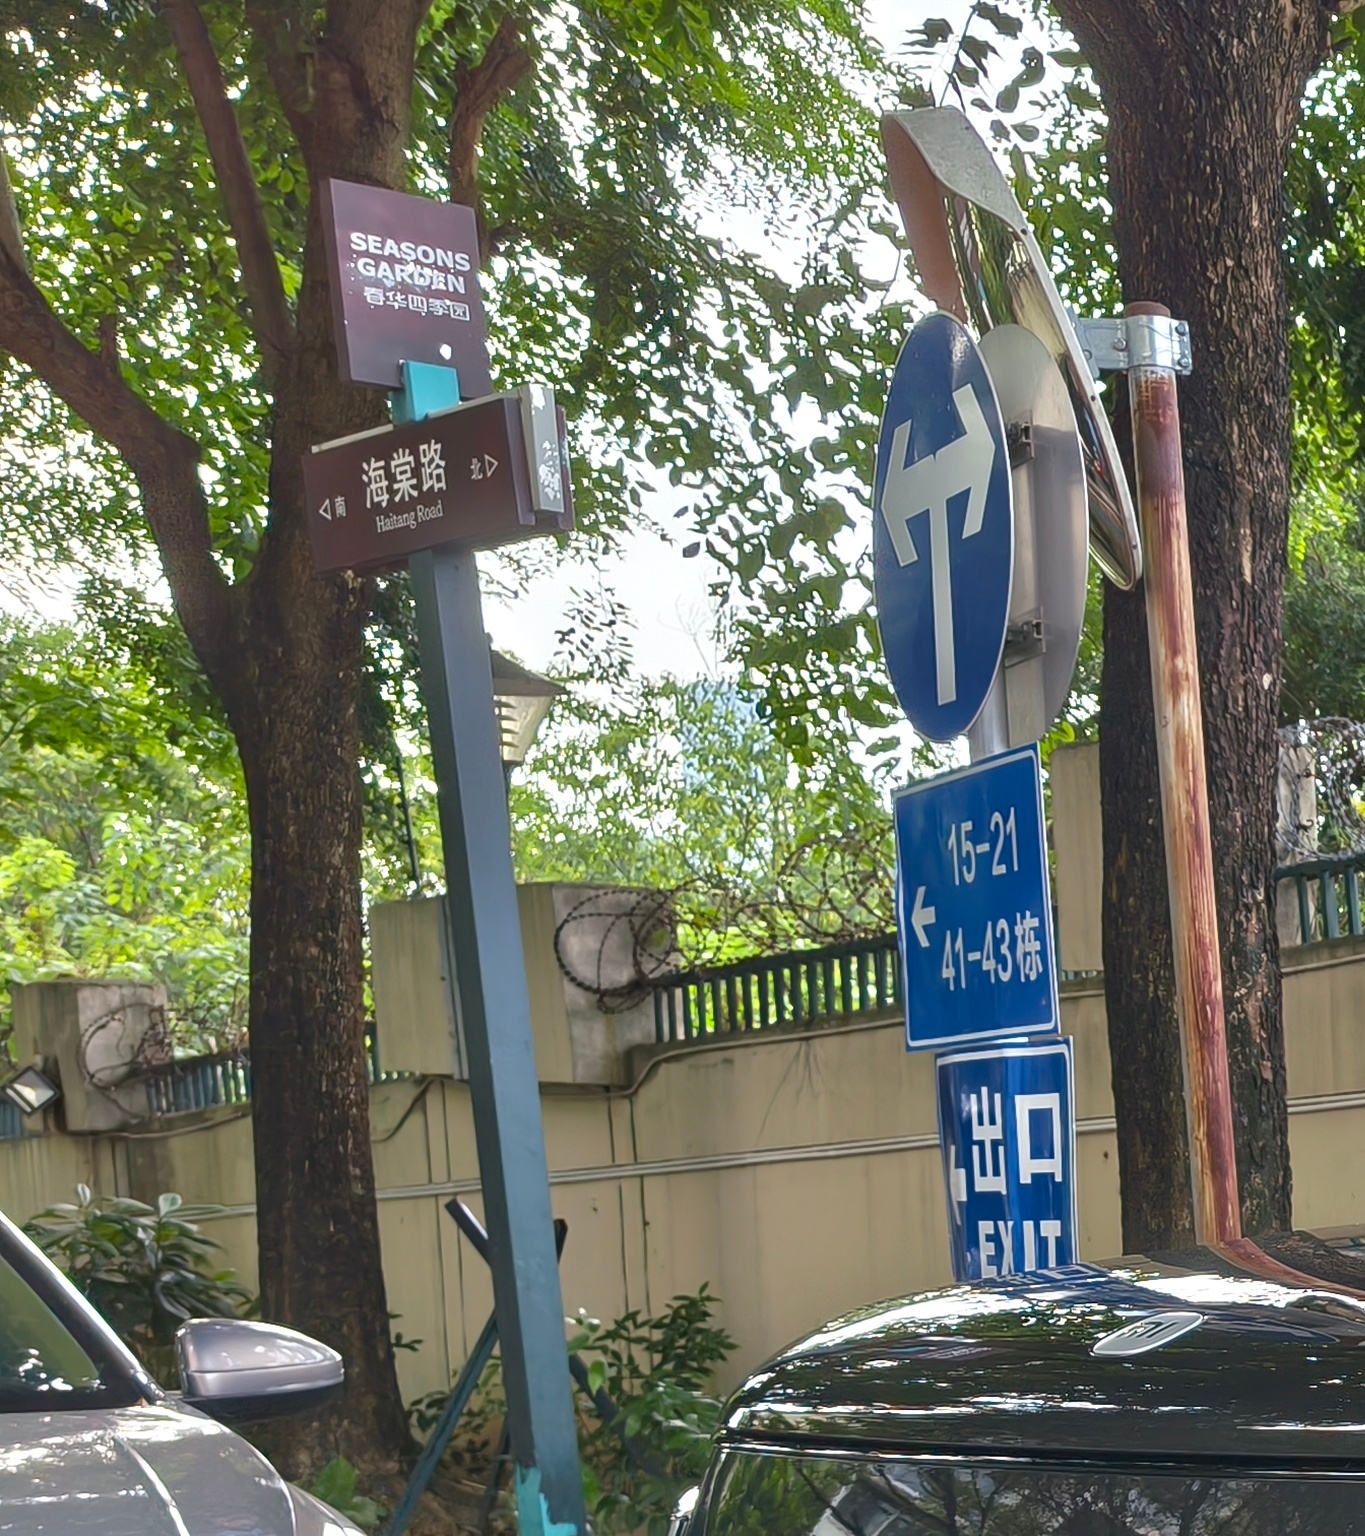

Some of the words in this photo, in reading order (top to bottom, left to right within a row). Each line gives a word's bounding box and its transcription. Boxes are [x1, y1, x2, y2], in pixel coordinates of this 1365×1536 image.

[350, 231, 471, 272] SEASONS
[357, 257, 466, 294] GARDEN
[363, 286, 471, 321] 春华四季园
[335, 495, 347, 518] 南
[362, 439, 447, 509] 海棠路
[470, 458, 483, 480] 北
[376, 510, 418, 533] Haitang
[416, 500, 444, 523] Road
[948, 806, 1019, 886] 15-21
[942, 910, 1043, 991] 41-43栋
[969, 1086, 1063, 1195] 出口
[978, 1220, 1062, 1279] EXIT
